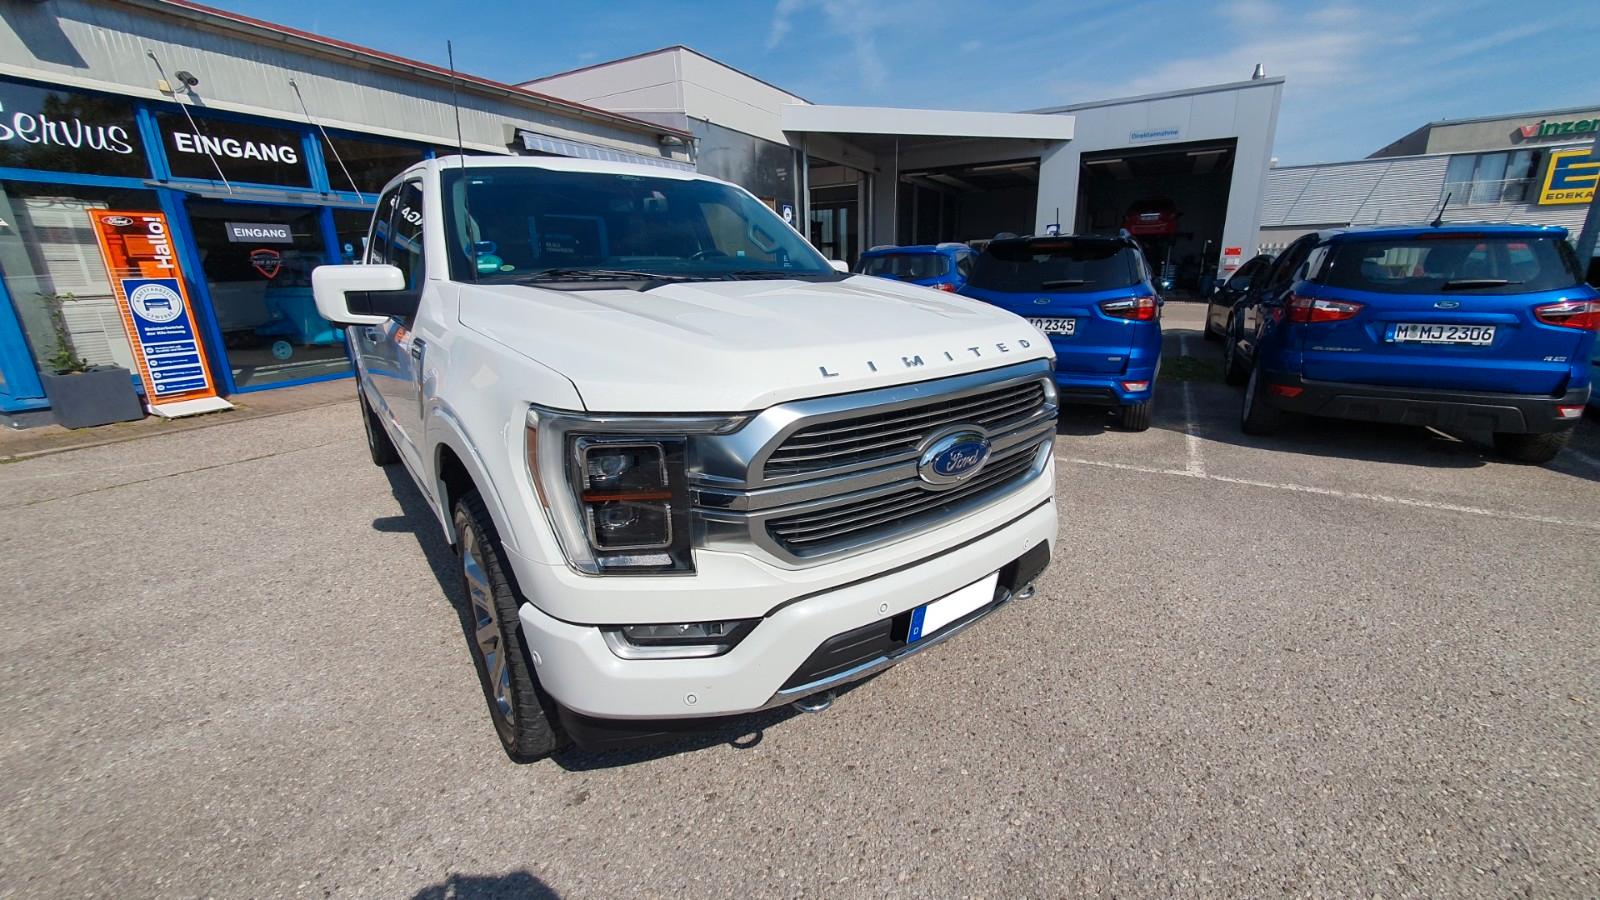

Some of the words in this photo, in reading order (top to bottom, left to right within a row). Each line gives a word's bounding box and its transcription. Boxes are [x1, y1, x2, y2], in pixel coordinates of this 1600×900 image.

[174, 132, 298, 164] EINGANG
[1545, 191, 1594, 201] EDEKA
[142, 216, 175, 269] Hallo!
[233, 228, 287, 238] EINGANG
[1044, 319, 1075, 331] 2345
[1396, 325, 1409, 338] M
[1419, 326, 1443, 339] MJ
[1446, 327, 1493, 341] 2306
[819, 339, 1031, 378] LIMITED
[946, 449, 979, 472] Ford
